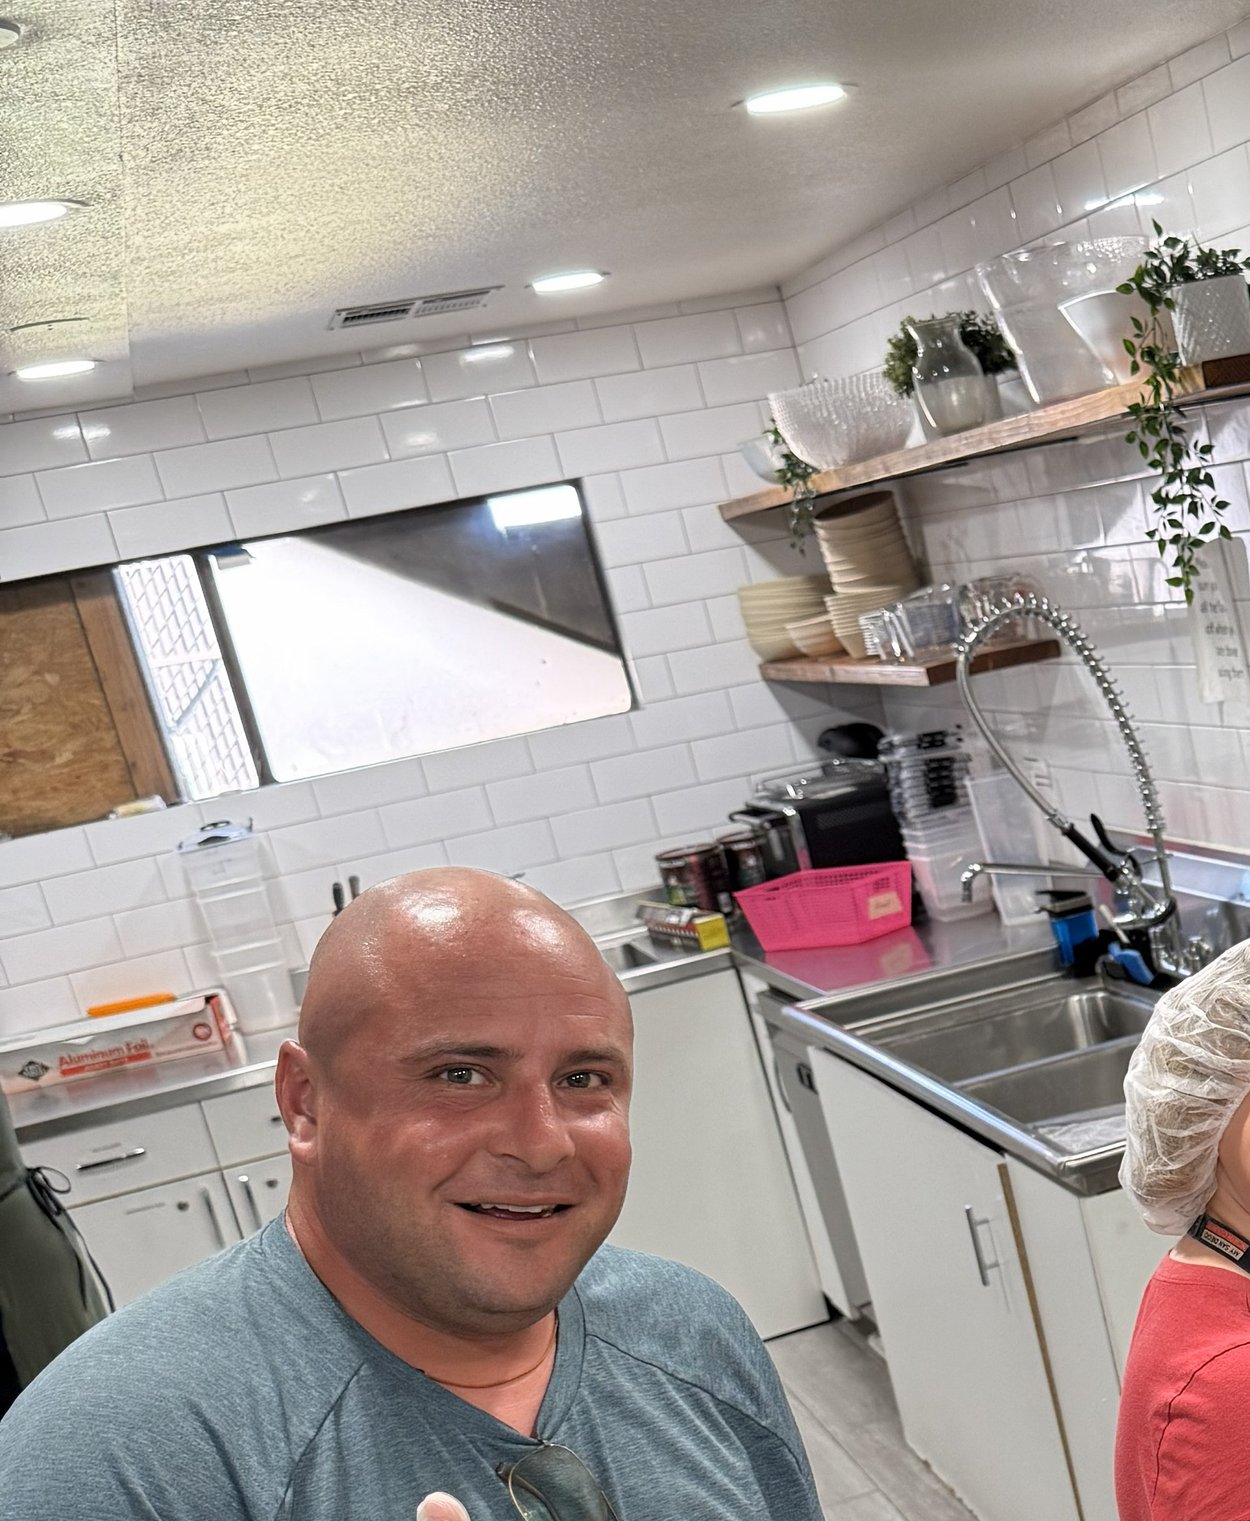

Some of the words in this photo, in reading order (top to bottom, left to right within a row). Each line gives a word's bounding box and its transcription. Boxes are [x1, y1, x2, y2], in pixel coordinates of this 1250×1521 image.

[59, 1045, 125, 1068] Aluminum
[124, 1039, 150, 1058] Foil
[1203, 1231, 1220, 1246] DIEGO
[1218, 1240, 1231, 1252] SAN
[1229, 1246, 1241, 1258] MY
